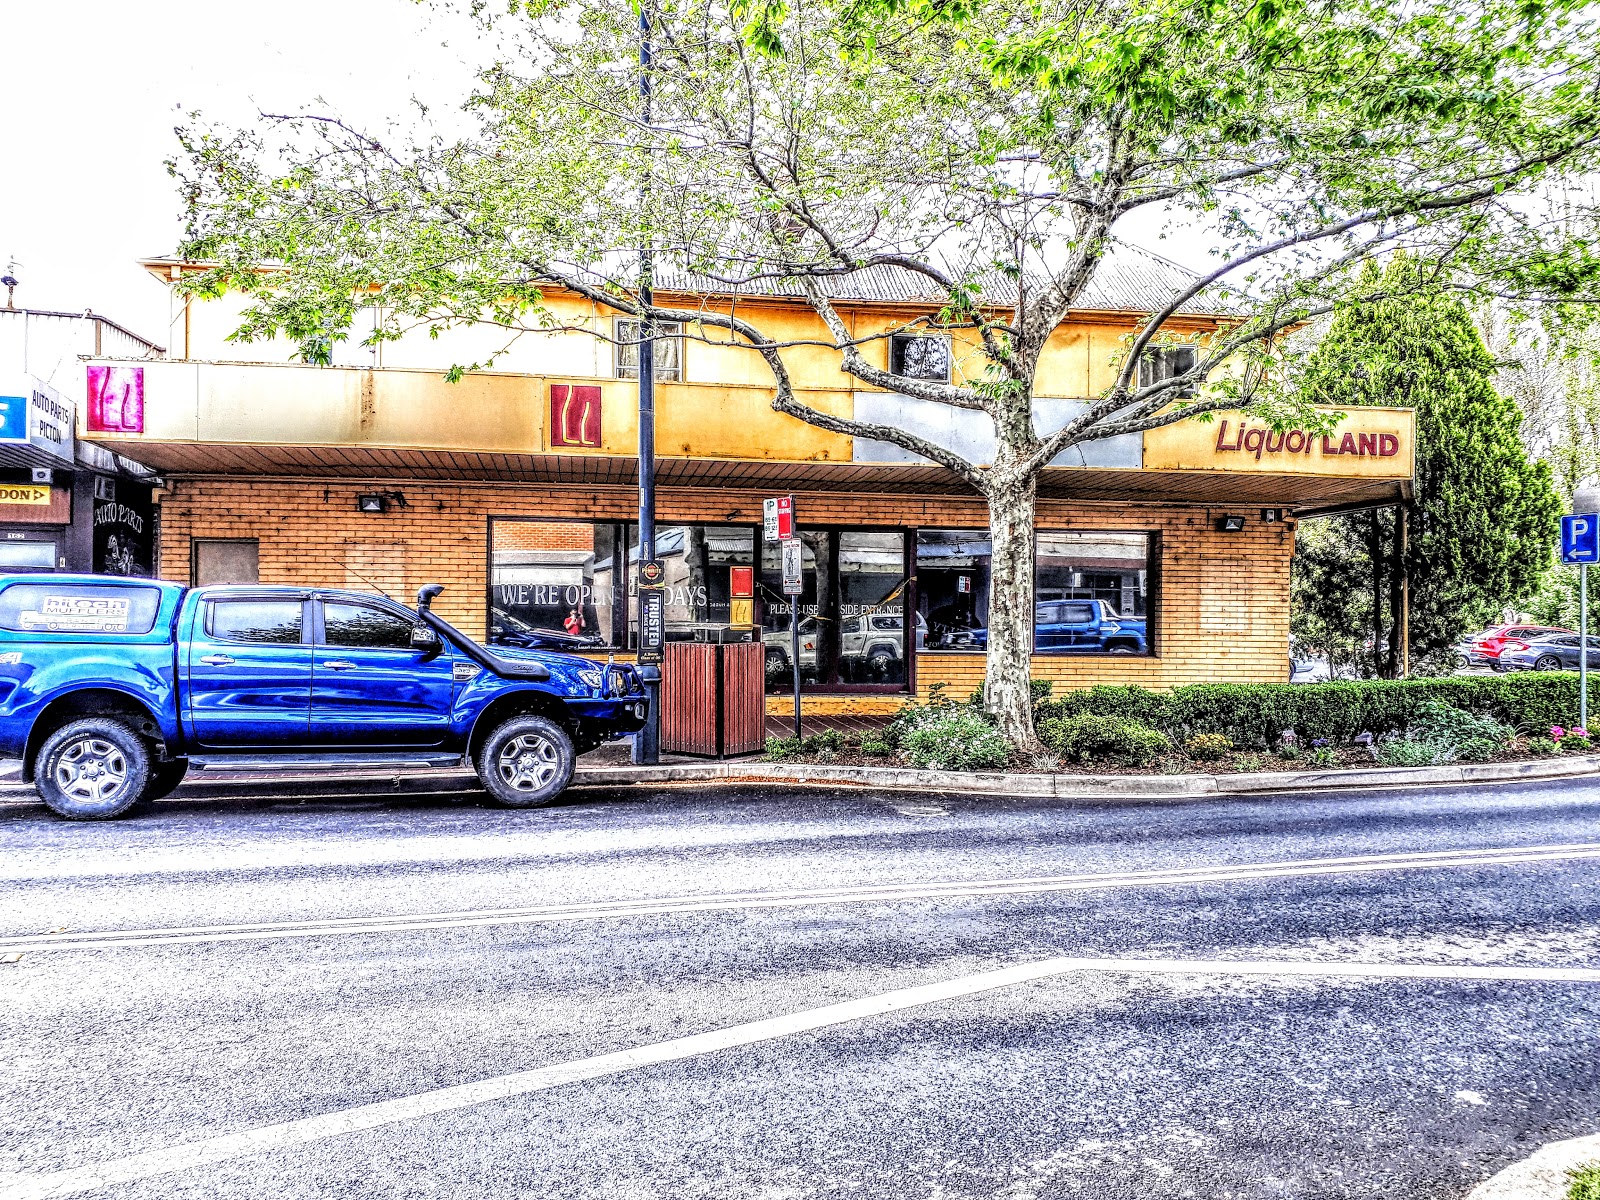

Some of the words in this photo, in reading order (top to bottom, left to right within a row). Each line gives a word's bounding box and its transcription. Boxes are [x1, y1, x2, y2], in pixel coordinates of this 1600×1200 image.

[32, 389, 50, 413] AUTO
[50, 400, 69, 425] PARTS
[39, 419, 62, 445] PICTON
[94, 502, 118, 526] AUTO
[118, 504, 144, 533] PARTS
[1570, 518, 1589, 546] P
[565, 583, 615, 606] OPEN
[46, 607, 126, 615] MUFFLERS
[648, 595, 660, 647] TRUSTED
[802, 604, 819, 615] USE
[840, 603, 859, 615] SIDE
